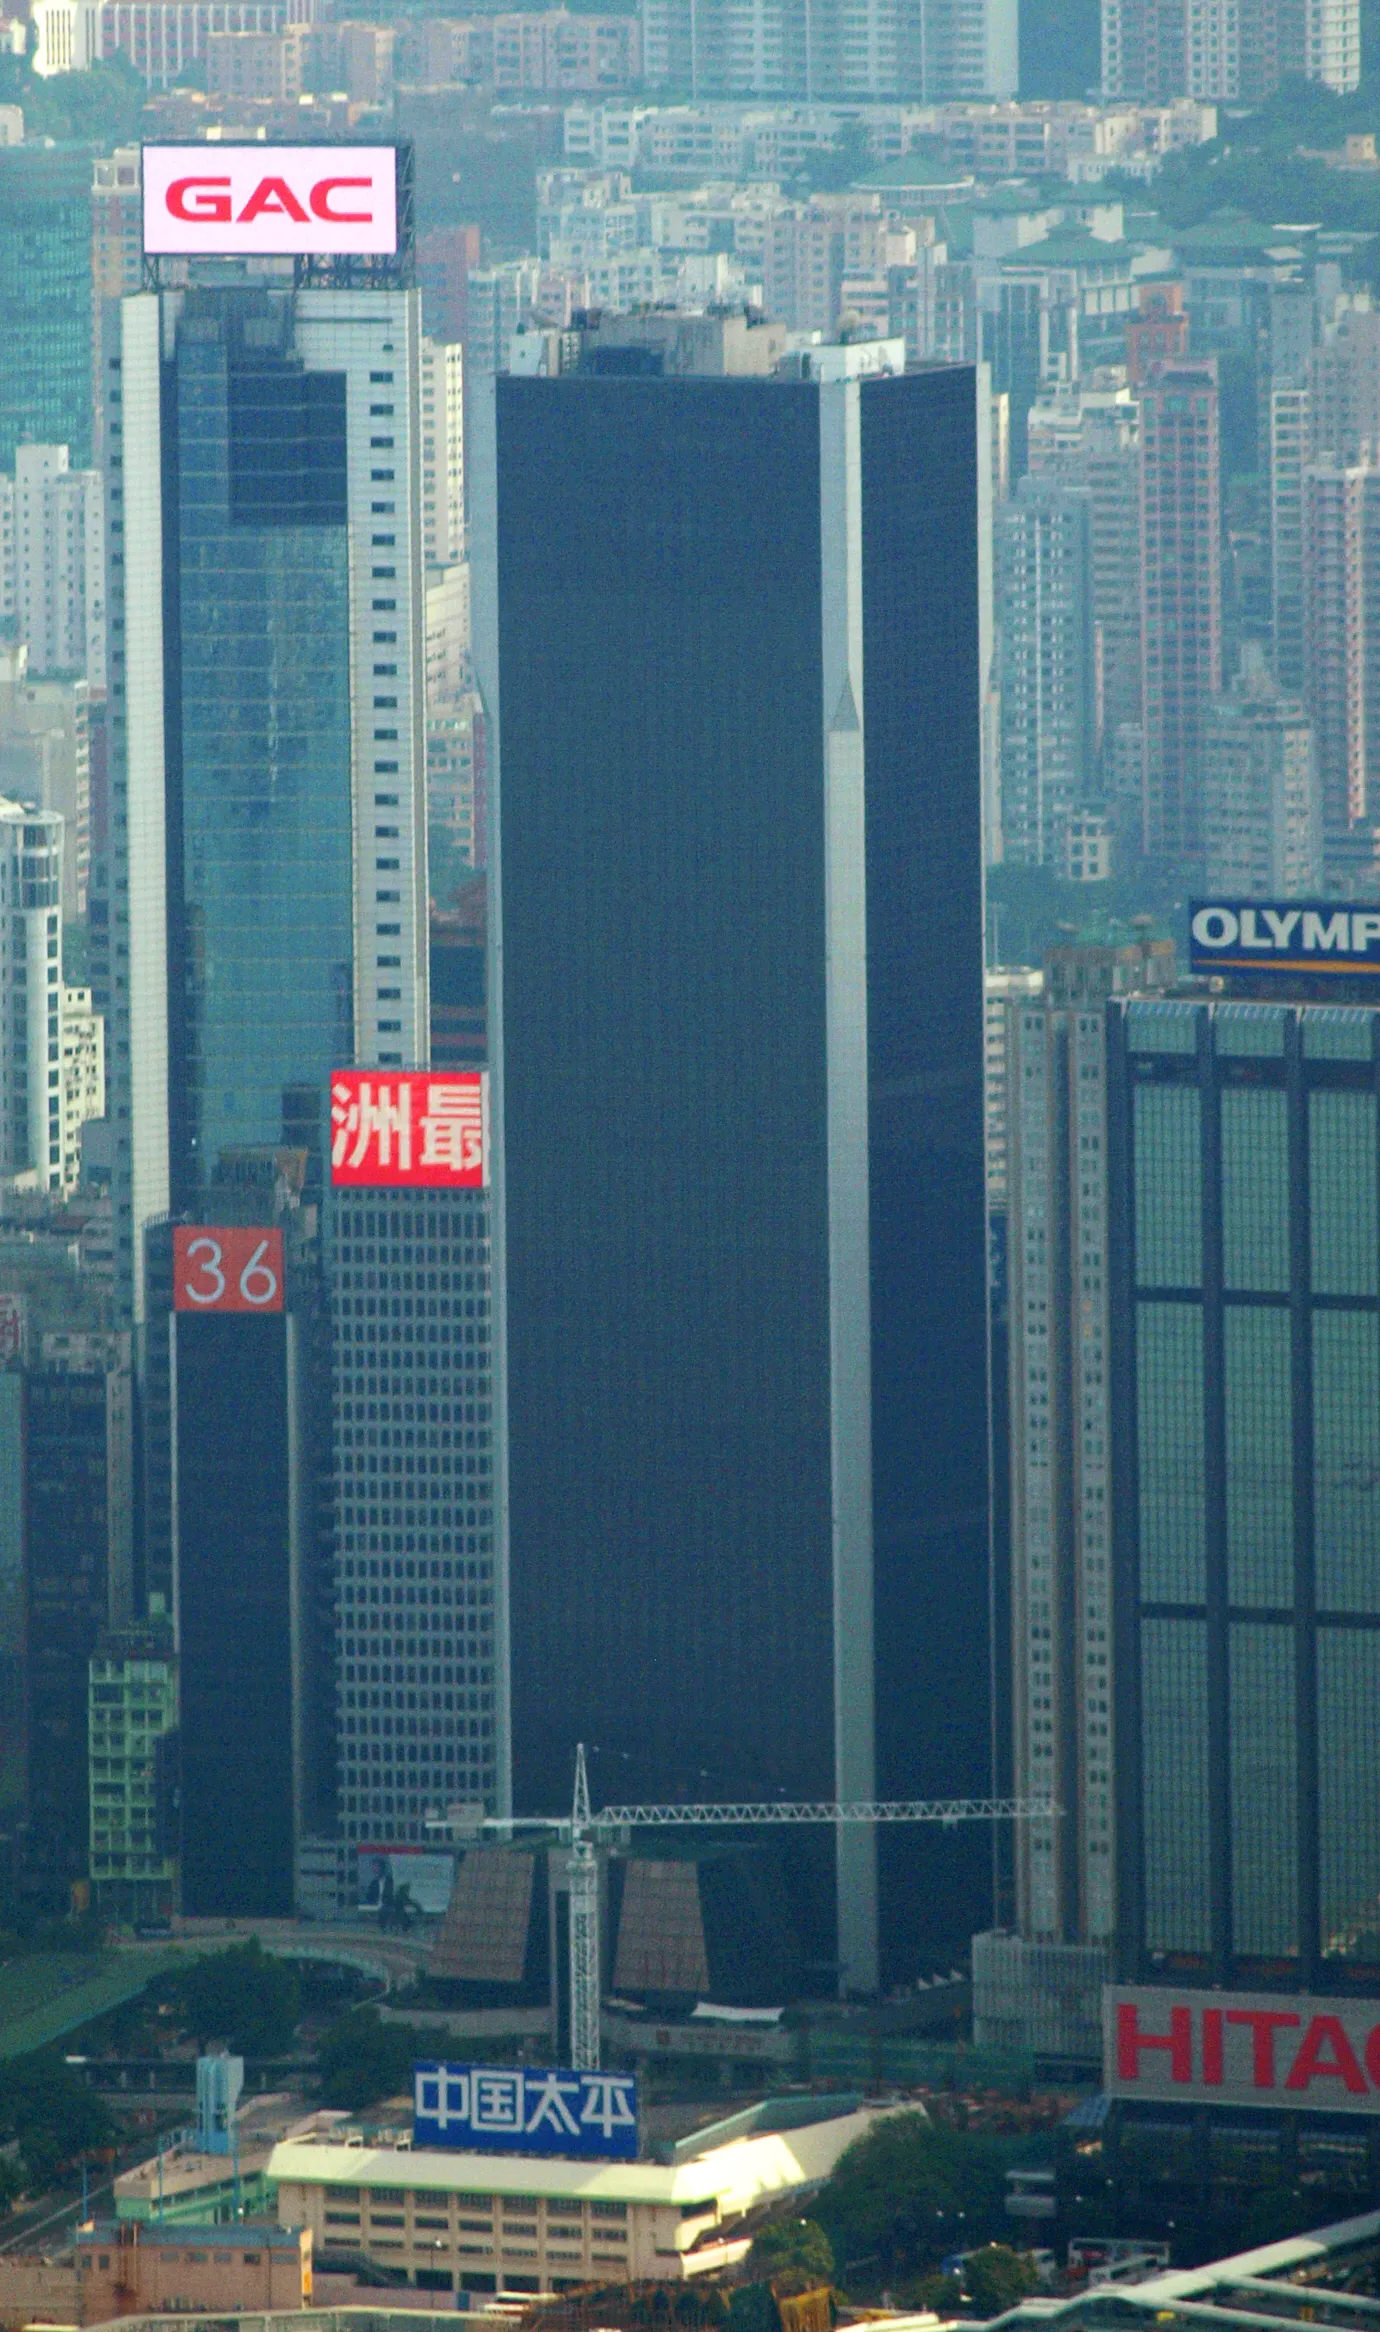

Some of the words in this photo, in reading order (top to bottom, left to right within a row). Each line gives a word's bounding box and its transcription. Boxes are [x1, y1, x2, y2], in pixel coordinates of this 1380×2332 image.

[165, 176, 373, 223] GAC
[1192, 907, 1380, 951] OLYMP
[185, 1238, 277, 1304] 36
[1117, 2003, 1380, 2094] HITA
[415, 2066, 635, 2138] 中国太平
